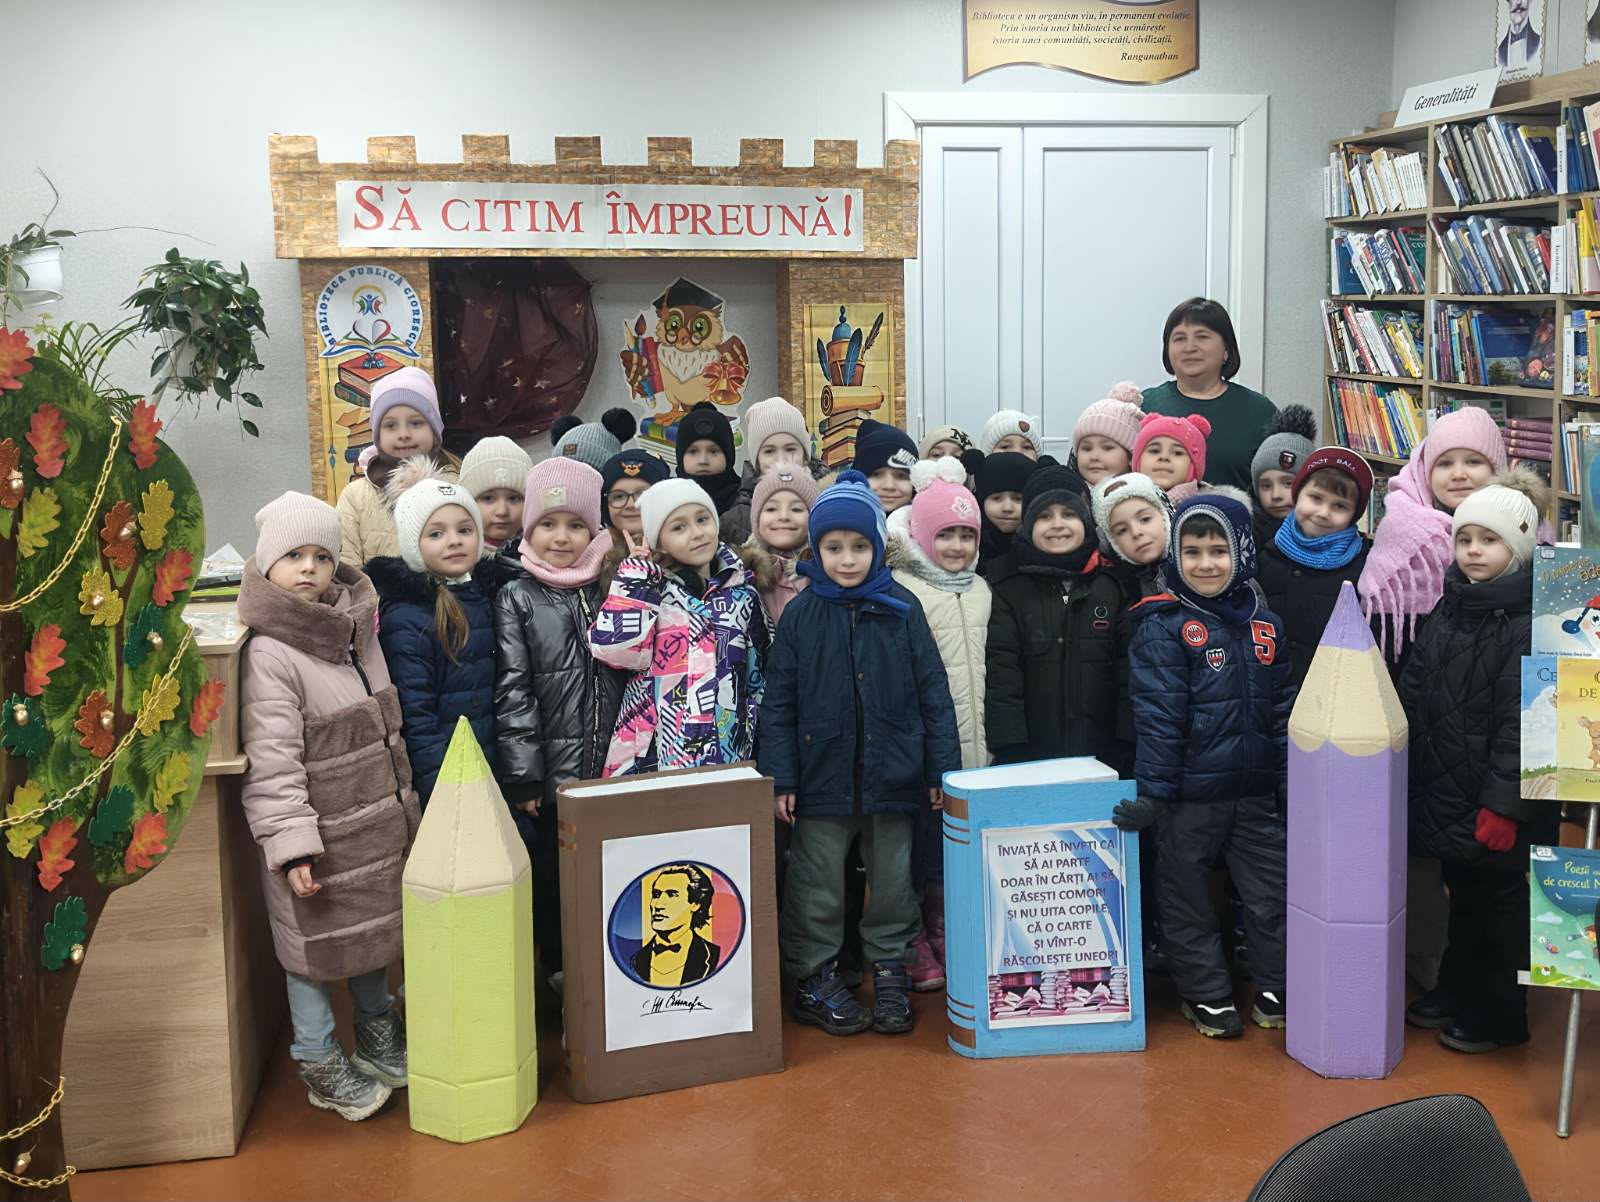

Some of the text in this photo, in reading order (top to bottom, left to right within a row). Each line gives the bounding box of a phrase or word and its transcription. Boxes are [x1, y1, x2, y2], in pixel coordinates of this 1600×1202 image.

[973, 11, 1015, 20] Biblioteca
[1038, 11, 1079, 23] organism
[1081, 11, 1097, 21] viu,
[1109, 11, 1156, 22] permanent
[1000, 23, 1019, 32] Prin
[1021, 23, 1048, 32] istoria
[1050, 23, 1070, 32] unei
[1071, 23, 1110, 32] biblioteci
[992, 35, 1020, 44] istoria
[1021, 35, 1041, 44] unei
[1120, 51, 1179, 63] Ranganathan
[353, 185, 853, 238] SĂ CITIM ÎMPREUNĂ!
[319, 275, 346, 346] BIBLIOTECA
[403, 287, 421, 347] CIORESCU
[1336, 458, 1357, 473] BALL
[1249, 619, 1277, 667] 5
[654, 632, 689, 671] EASY
[1579, 687, 1597, 699] DE
[1043, 840, 1058, 854] SĂ
[1100, 839, 1115, 850] CA
[1024, 857, 1091, 871] SĂ AI PARTE
[1564, 861, 1590, 875] Poezii
[1000, 876, 1033, 888] DOAR
[1034, 873, 1048, 886] ÎN
[1543, 876, 1556, 887] de
[1059, 888, 1105, 900] COMORI
[1020, 908, 1037, 919] NU
[1040, 906, 1066, 918] UITA
[1027, 920, 1092, 934] CĂ O CARTE
[1046, 935, 1087, 949] VÎNT-O
